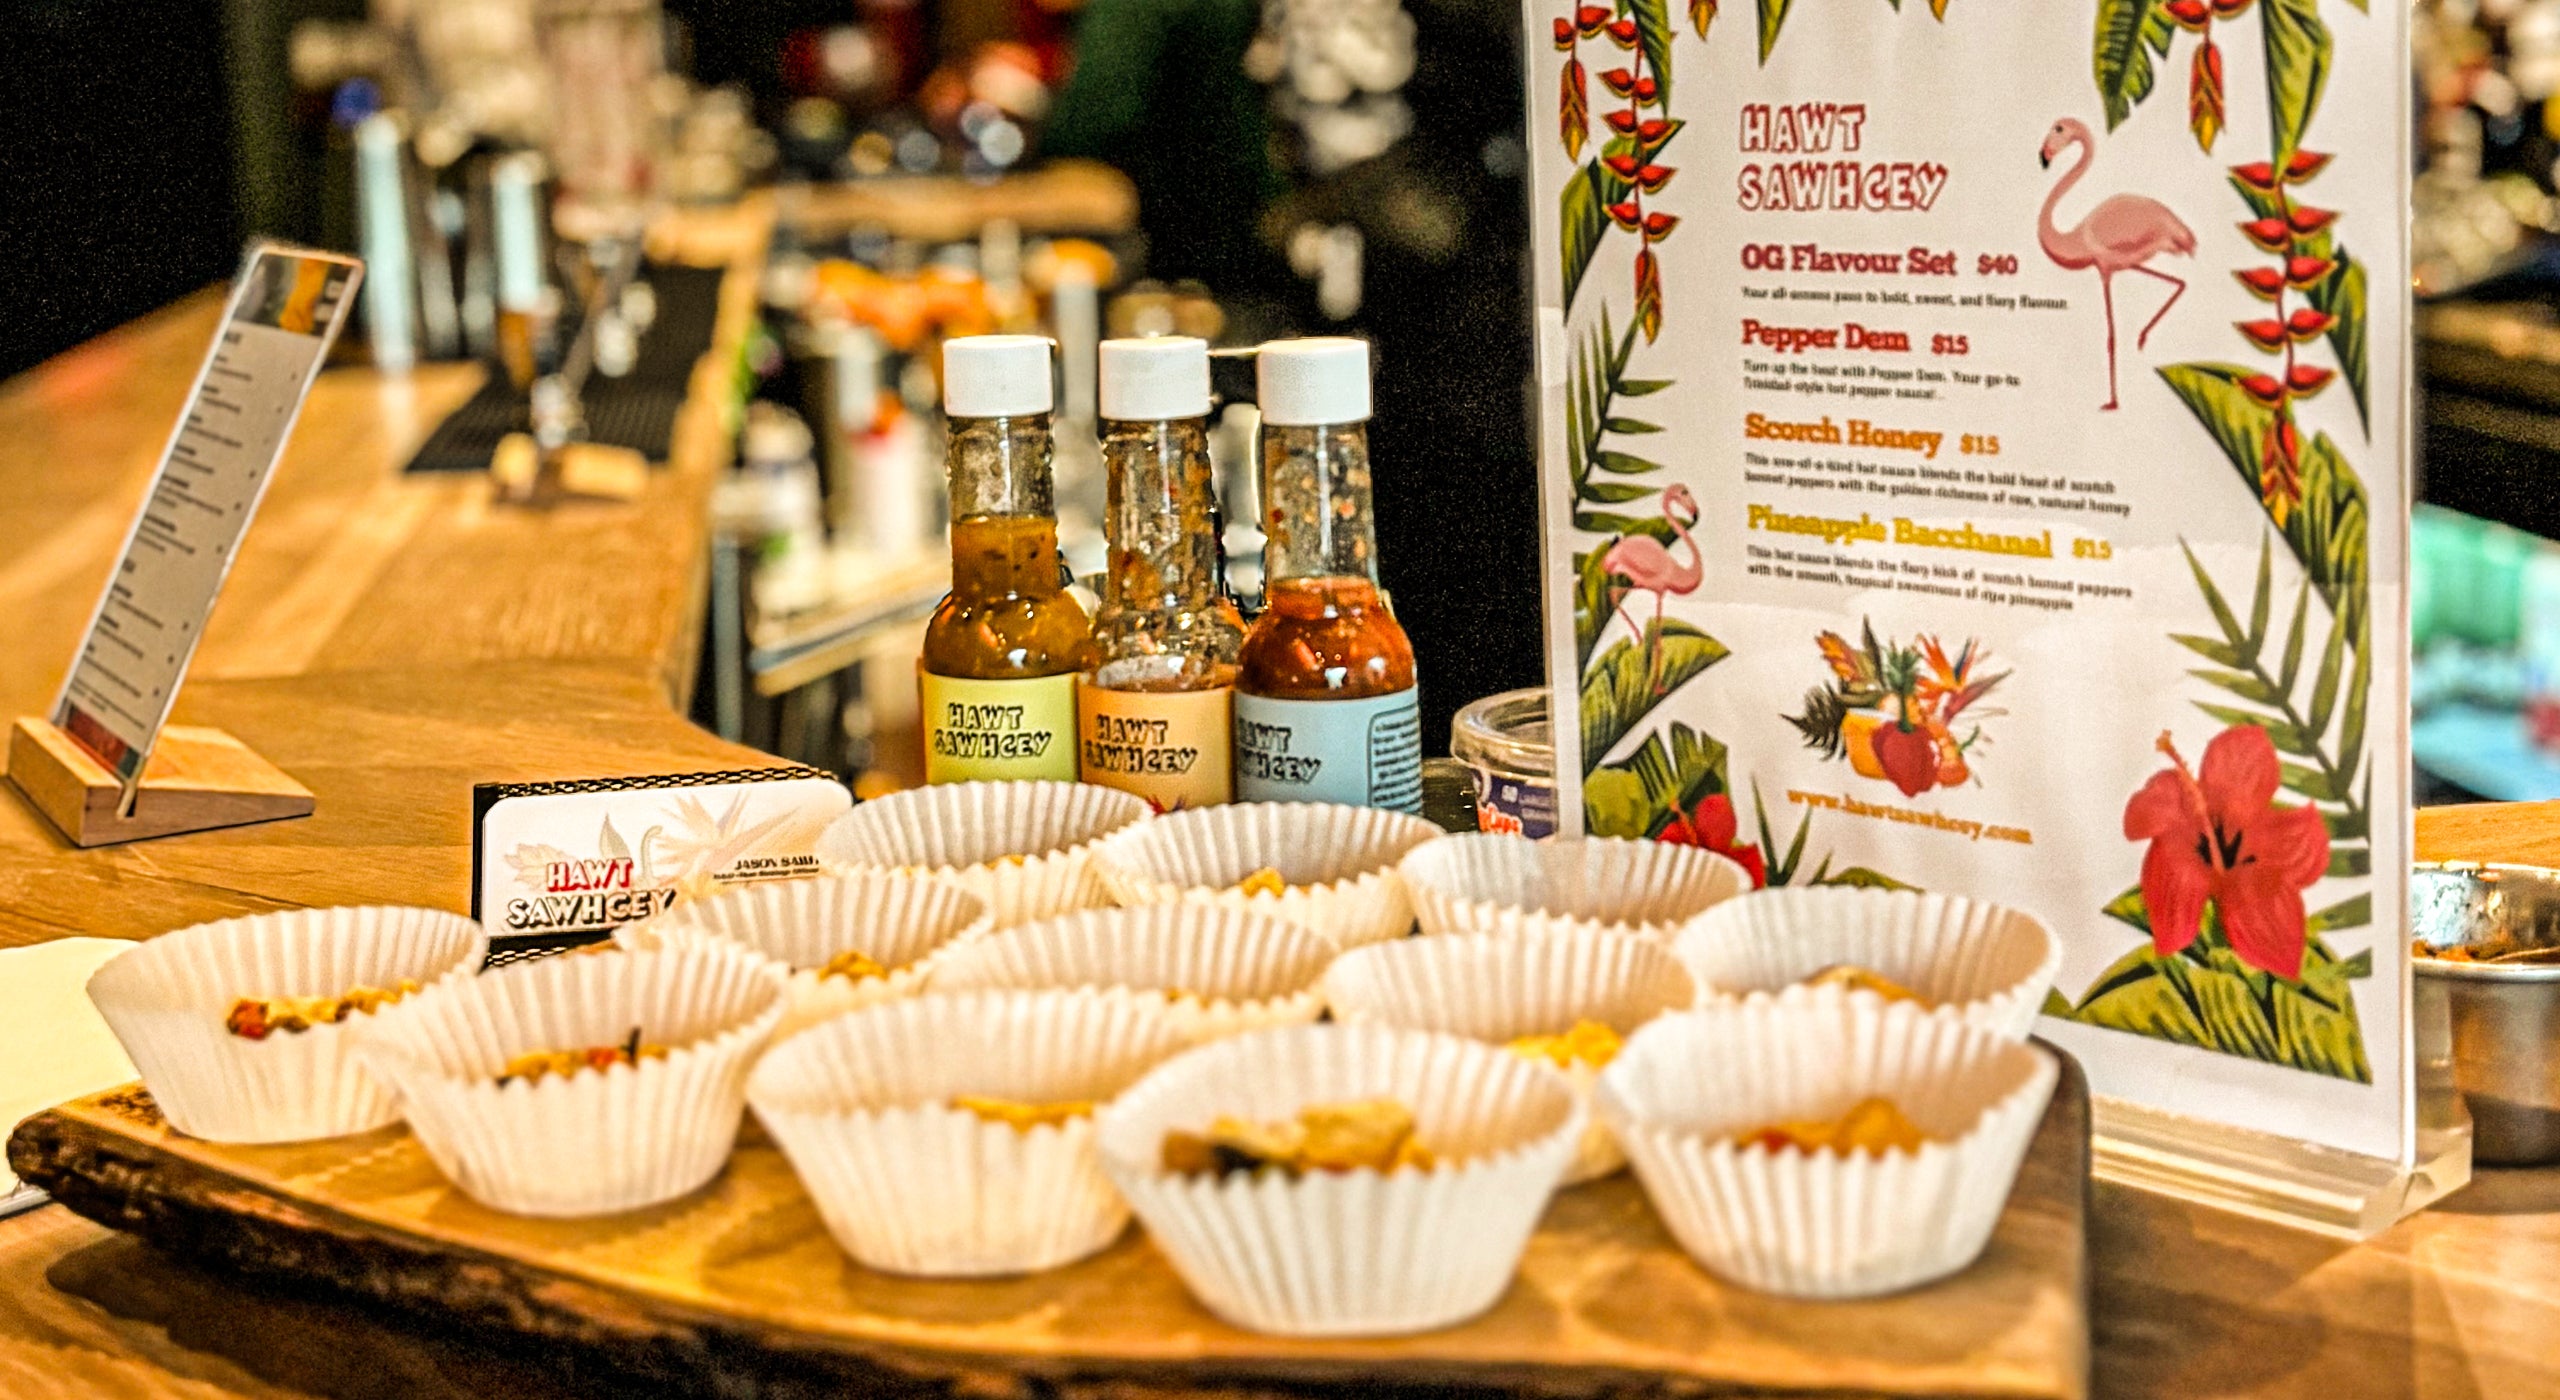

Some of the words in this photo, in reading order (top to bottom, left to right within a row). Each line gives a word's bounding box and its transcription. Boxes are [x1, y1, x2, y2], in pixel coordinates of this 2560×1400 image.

[1739, 103, 1866, 154] HAWT
[1737, 162, 1948, 212] SAWHCEY
[1741, 243, 1786, 271] OG
[1791, 243, 1901, 274] Flavour
[1907, 248, 1957, 276] Set
[1978, 253, 2018, 276] $40
[1960, 293, 1982, 306] and
[1741, 318, 1838, 354] Pepper
[1844, 322, 1910, 352] Dem
[1931, 333, 1969, 356] $15
[1744, 359, 1768, 372] Turn
[1790, 363, 1808, 374] the
[1811, 364, 1838, 375] heat
[1841, 366, 1866, 377] with
[1826, 383, 1846, 394] hot
[1849, 385, 1891, 397] pepper
[1745, 412, 1840, 446] Scorch
[1847, 419, 1944, 459] Honey
[1959, 433, 1999, 456] $15
[1745, 452, 1769, 466] This
[1856, 460, 1877, 474] hot
[1880, 465, 1916, 477] sauce
[1918, 464, 1961, 481] blends
[1964, 470, 1984, 483] the
[1988, 472, 2016, 486] bold
[2019, 474, 2048, 488] heat
[2051, 476, 2066, 490] of
[1787, 475, 1835, 490] peppers
[1838, 478, 1862, 491] with
[1866, 480, 1886, 493] the
[1890, 482, 1932, 498] golden
[1992, 490, 2006, 503] of
[2038, 497, 2086, 510] natural
[2089, 498, 2131, 518] honey
[1748, 504, 1886, 545] Pineapple
[1894, 517, 2052, 559] Bacchanal
[2073, 538, 2112, 560] $15
[1747, 544, 1771, 559] This
[1774, 548, 1794, 561] hot
[1797, 553, 1830, 565] sauce
[1833, 554, 1873, 570] blends
[1877, 558, 1897, 572] the
[1962, 569, 1975, 581] of
[2077, 582, 2132, 598] peppers
[1748, 564, 1771, 576] with
[1774, 565, 1793, 578] the
[1845, 574, 1894, 590] tropical
[1965, 587, 1978, 599] of
[2008, 592, 2073, 611] pineapple
[947, 701, 1024, 731] HAWT
[1096, 714, 1169, 744] HAWT
[934, 729, 1053, 759] SAWHCEY
[547, 857, 633, 893] HAWT
[735, 858, 777, 870] JASON
[507, 888, 676, 928] SAWHCEY
